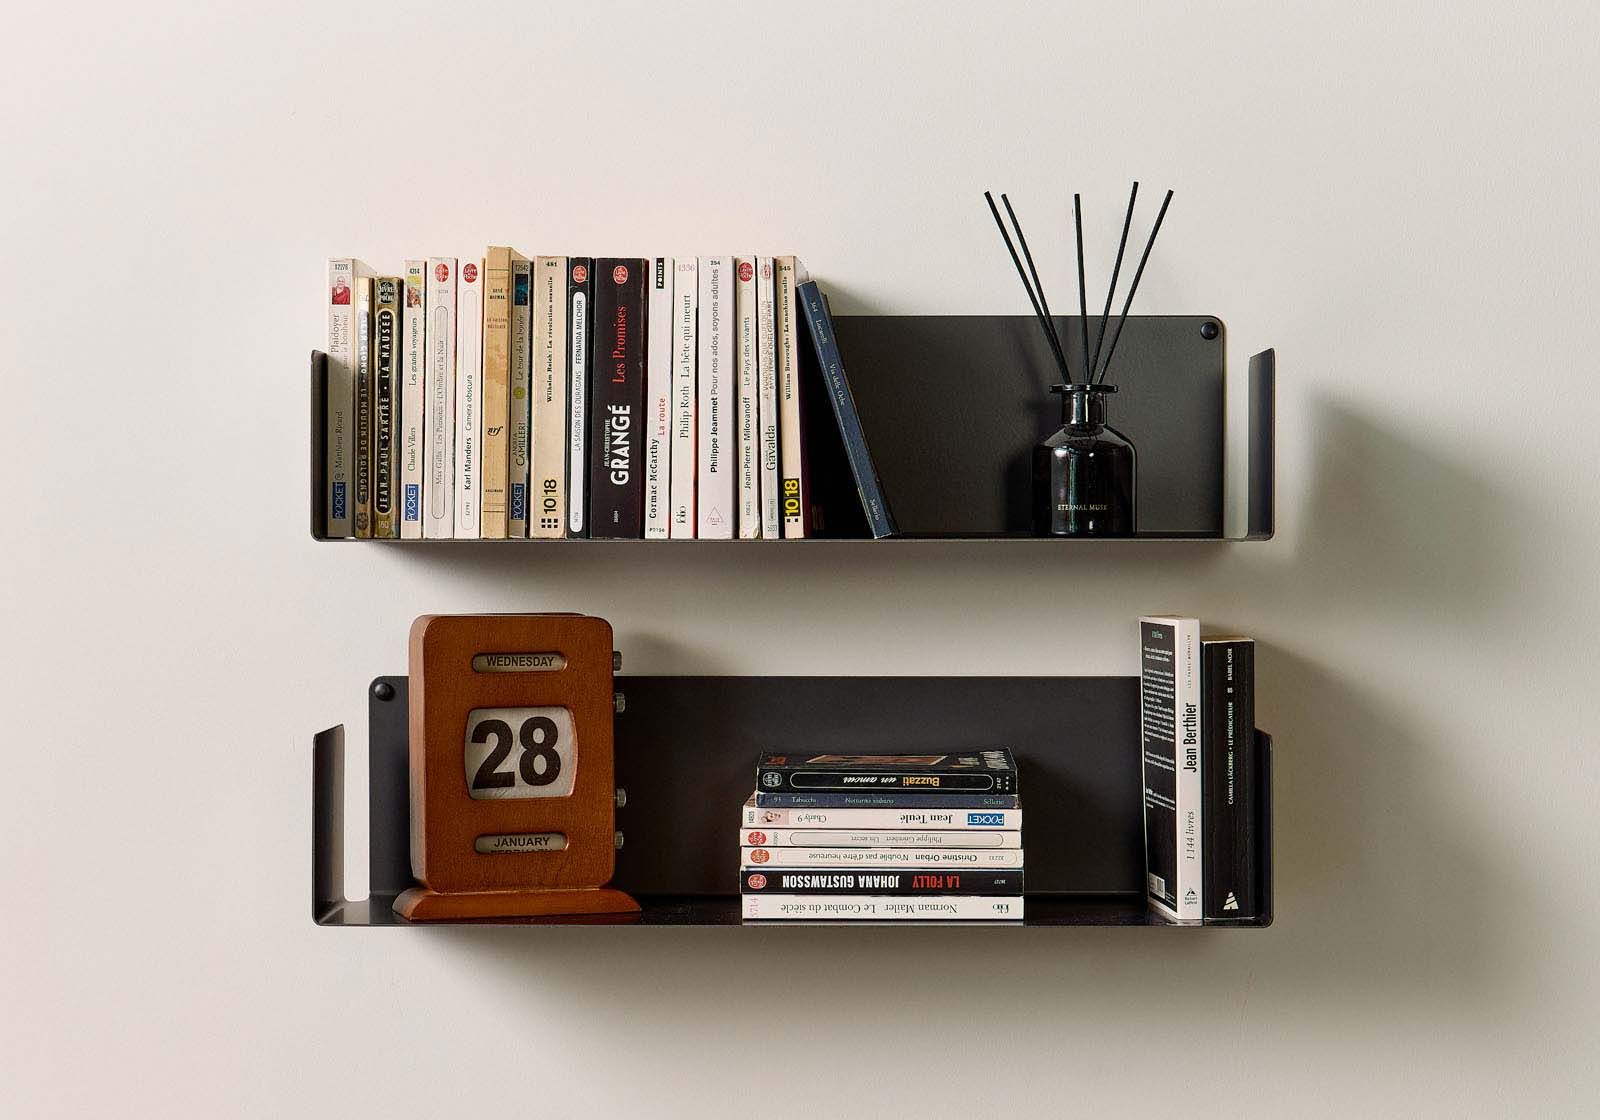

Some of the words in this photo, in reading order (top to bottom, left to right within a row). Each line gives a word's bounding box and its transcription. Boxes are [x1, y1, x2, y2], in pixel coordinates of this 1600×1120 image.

[711, 268, 719, 300] adultes
[712, 302, 720, 332] soyons
[331, 314, 342, 353] Plaidoyer
[411, 317, 419, 350] voyageurs
[612, 306, 626, 359] Promises
[682, 326, 693, 341] qui
[742, 316, 750, 340] vivants
[784, 324, 790, 333] La
[547, 340, 553, 349] La
[711, 333, 720, 356] ados,
[681, 344, 690, 365] bête
[409, 352, 419, 372] grands
[744, 362, 752, 376] Pays
[381, 366, 390, 378] LA
[516, 371, 524, 380] Le
[612, 362, 626, 384] Les
[681, 366, 690, 378] La
[409, 373, 417, 386] Les
[744, 377, 750, 386] Le
[680, 386, 689, 408] Roth
[335, 411, 343, 434] Ricard
[380, 397, 390, 441] SARTRE
[680, 410, 692, 438] Philip
[742, 396, 751, 441] Milovanoff
[487, 425, 504, 436] nrf
[658, 425, 664, 436] La
[574, 442, 580, 451] LA
[607, 404, 630, 486] GRANGÉ
[765, 424, 776, 470] Gavalda
[408, 449, 416, 472] Claude
[649, 438, 660, 481] McCarthy
[710, 437, 720, 473] Philippe
[380, 447, 389, 509] JEAN-PAUL
[334, 483, 345, 520] POCKET
[406, 485, 416, 520] POCKET
[514, 484, 523, 520] POCKET
[649, 484, 658, 518] Cormac
[676, 505, 687, 524] folio
[486, 656, 554, 667] WEDNESDAY
[1182, 702, 1197, 744] Berthier
[470, 716, 562, 790] 28
[1184, 748, 1197, 773] Jean
[843, 776, 878, 784] amour
[902, 776, 940, 786] Buzzati
[804, 814, 827, 824] Charly
[900, 814, 928, 824] Teulé
[930, 814, 953, 824] Jean
[968, 814, 1004, 825] POCKET
[1186, 810, 1195, 835] livres
[494, 836, 550, 848] JANUARY
[1186, 838, 1195, 852] 144
[842, 852, 864, 862] d'être
[879, 853, 909, 862] N'oublie
[942, 854, 978, 862] Christine
[782, 874, 855, 888] GUSTAWSSON
[858, 874, 900, 888] JOHANA
[912, 875, 944, 889] FOLLY
[946, 875, 960, 889] LA
[780, 902, 808, 914] siècle
[808, 904, 822, 914] du
[824, 904, 862, 914] Combat
[863, 904, 876, 914] Le
[884, 904, 915, 914] Mailer
[918, 904, 958, 914] Norman
[992, 903, 1010, 914] folio
